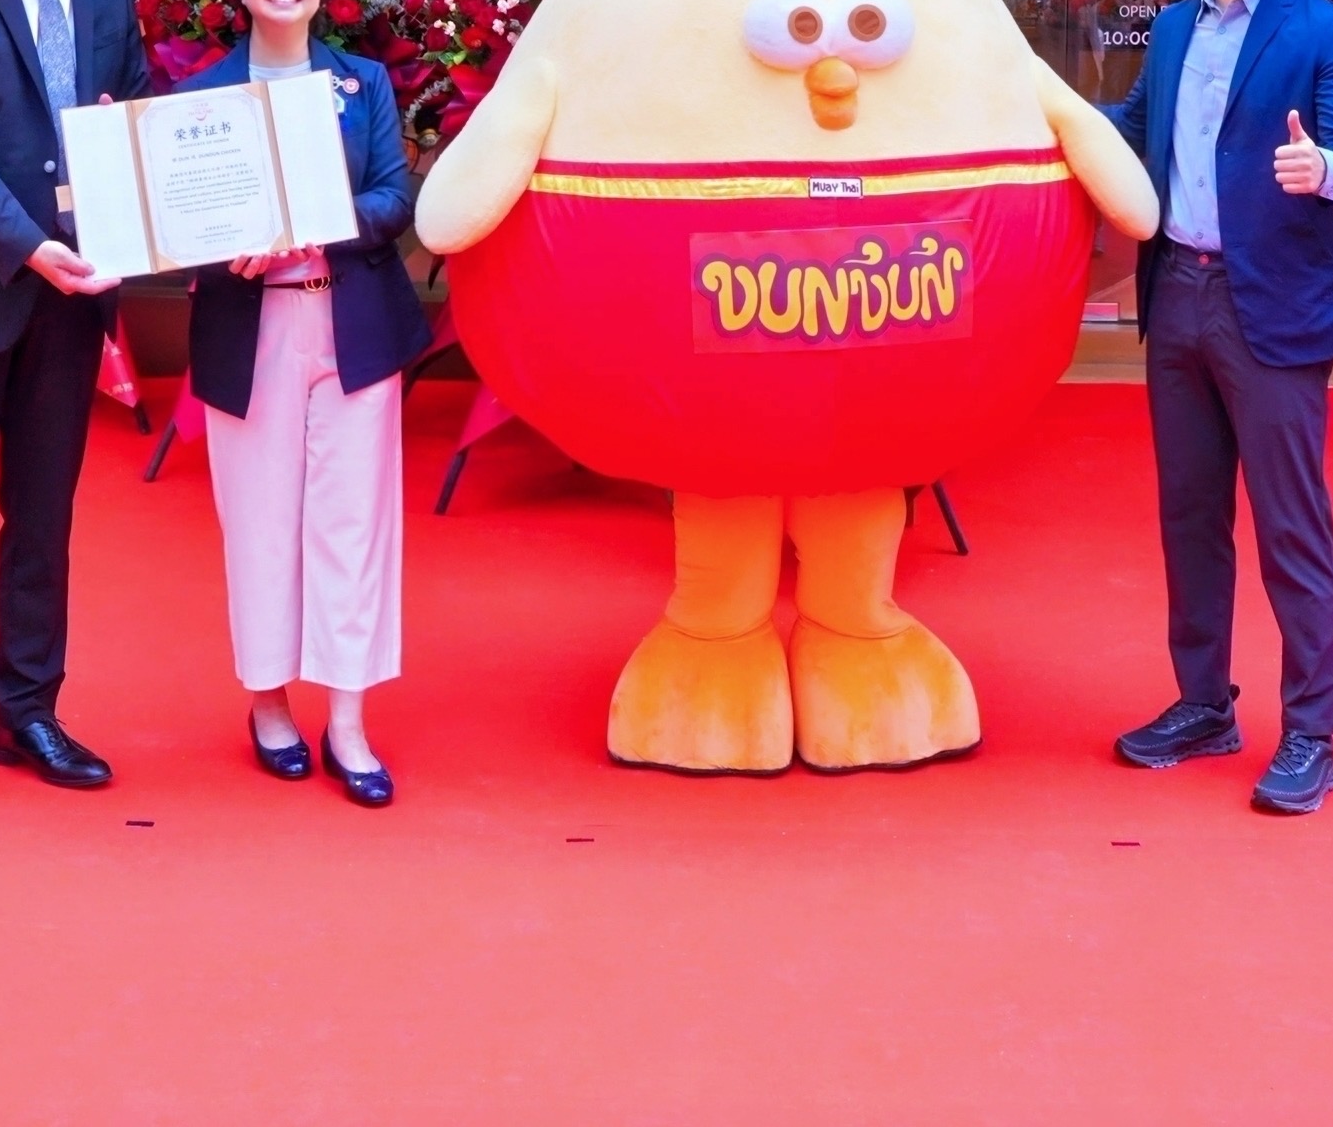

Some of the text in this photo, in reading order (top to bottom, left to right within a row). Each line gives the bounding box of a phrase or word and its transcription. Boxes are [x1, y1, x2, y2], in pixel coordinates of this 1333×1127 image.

[1119, 5, 1156, 18] OPEN
[174, 121, 232, 142] 荣誉证书
[840, 181, 859, 193] Thai
